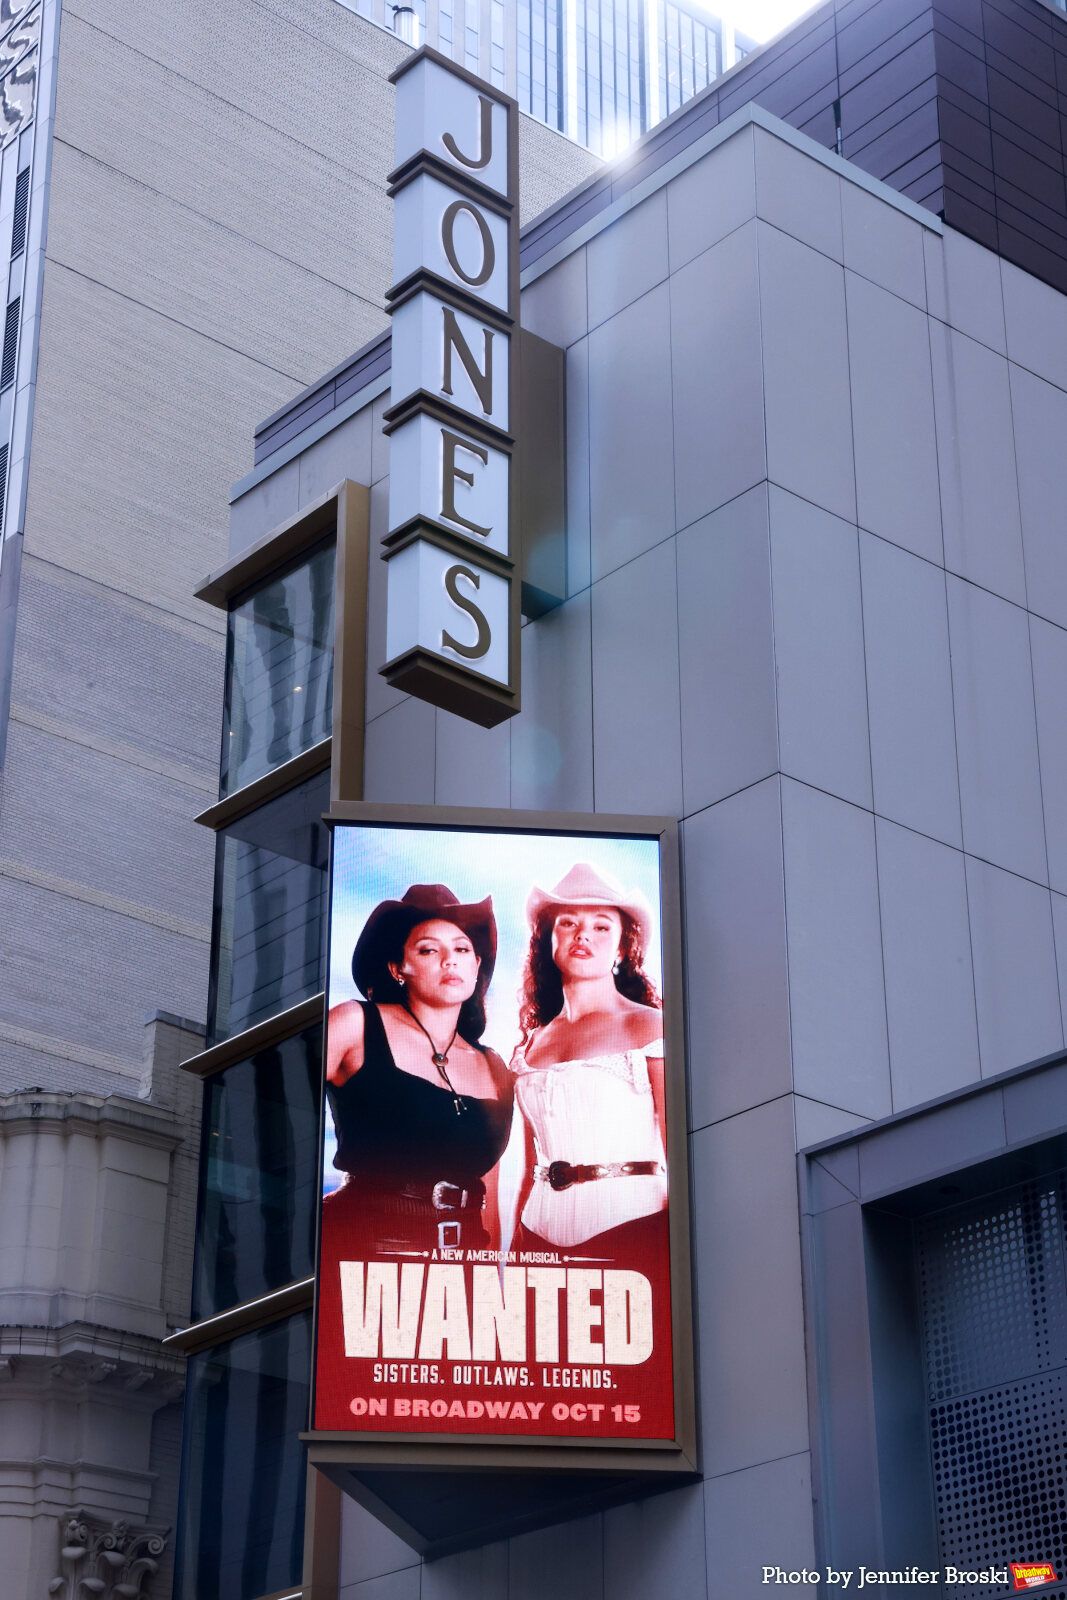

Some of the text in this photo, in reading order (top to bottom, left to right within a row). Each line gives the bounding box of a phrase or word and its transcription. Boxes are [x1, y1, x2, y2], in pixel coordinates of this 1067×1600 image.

[440, 95, 496, 661] JONES
[431, 1249, 562, 1264] A NEW AMERICAN MUSICAL
[339, 1260, 654, 1366] WANTED
[373, 1363, 618, 1390] SISTERS. OUTLAWS. LEGENDS.
[349, 1397, 641, 1423] ON BROADWAY OCT 15
